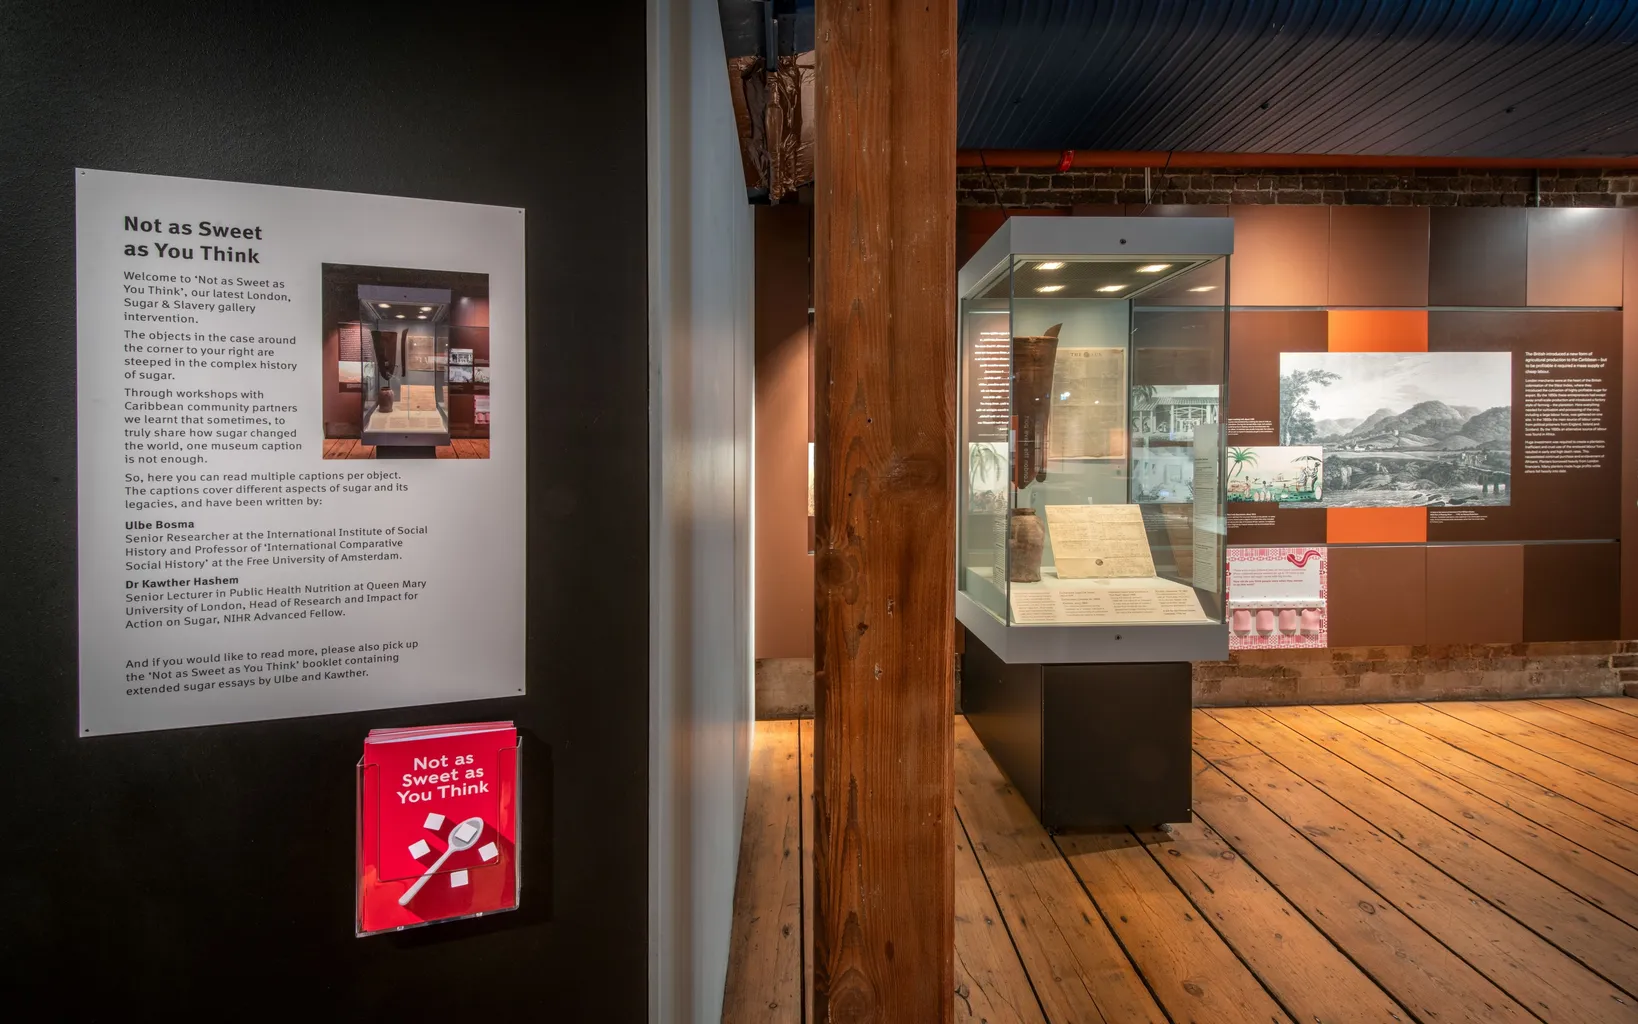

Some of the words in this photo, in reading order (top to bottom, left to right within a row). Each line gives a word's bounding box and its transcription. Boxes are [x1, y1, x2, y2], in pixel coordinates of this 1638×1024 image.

[124, 215, 162, 233] Not
[168, 222, 193, 236] as
[198, 221, 262, 240] Sweet
[124, 244, 149, 257] as
[154, 242, 194, 260] You
[200, 245, 260, 264] Think
[123, 271, 177, 283] Welcome
[180, 275, 191, 284] to
[194, 275, 218, 285] ‘Not
[221, 278, 234, 286] as
[236, 277, 270, 288] Sweet
[272, 281, 285, 289] as
[123, 284, 145, 294] You
[148, 285, 188, 297] Think’,
[191, 289, 210, 297] our
[213, 289, 244, 299] latest
[247, 291, 291, 302] London,
[124, 297, 159, 310] Sugar
[161, 300, 171, 309] &
[173, 300, 215, 312] Slavery
[218, 303, 256, 314] gallery
[124, 311, 199, 324] intervention.
[124, 330, 146, 340] The
[148, 331, 192, 342] objects
[194, 332, 205, 341] in
[208, 333, 227, 343] the
[229, 335, 255, 343] case
[258, 336, 296, 345] around
[124, 343, 143, 353] the
[146, 346, 184, 354] corner
[186, 346, 198, 355] to
[200, 347, 226, 357] your
[228, 346, 254, 358] right
[257, 349, 275, 357] are
[124, 357, 171, 368] steeped
[174, 357, 185, 367] in
[188, 358, 207, 368] the
[210, 360, 257, 370] complex
[260, 360, 297, 372] history
[124, 370, 137, 379] of
[139, 372, 175, 382] sugar.
[124, 388, 173, 400] Through
[176, 389, 238, 400] workshops
[240, 390, 264, 399] with
[124, 401, 184, 411] Caribbean
[187, 402, 250, 414] community
[252, 404, 298, 414] partners
[124, 416, 141, 424] we
[144, 414, 178, 424] learnt
[181, 415, 204, 425] that
[207, 415, 272, 426] sometimes,
[274, 417, 286, 425] to
[124, 428, 151, 439] truly
[154, 428, 186, 437] share
[189, 428, 213, 437] how
[216, 430, 248, 439] sugar
[250, 428, 297, 440] changed
[124, 441, 144, 450] the
[146, 441, 183, 451] world,
[186, 443, 208, 451] one
[261, 441, 302, 452] caption
[125, 454, 135, 464] is
[138, 455, 157, 464] not
[160, 454, 208, 465] enough.
[125, 473, 144, 483] So,
[147, 473, 173, 482] here
[176, 474, 196, 483] you
[200, 474, 220, 482] can
[223, 472, 247, 481] read
[251, 472, 296, 482] multiple
[298, 471, 344, 482] captions
[347, 473, 364, 482] per
[366, 471, 401, 481] object.
[125, 486, 147, 495] The
[149, 486, 200, 497] captions
[202, 487, 233, 495] cover
[235, 484, 283, 494] different
[285, 485, 327, 495] aspects
[329, 483, 341, 492] of
[342, 485, 372, 494] sugar
[374, 483, 393, 492] and
[396, 483, 408, 491] its
[125, 499, 177, 511] legacies,
[181, 498, 202, 508] and
[206, 498, 233, 507] have
[235, 498, 263, 507] been
[265, 497, 303, 506] written
[306, 496, 322, 507] by:
[125, 520, 153, 530] Ulbe
[155, 520, 195, 529] Bosma
[125, 533, 164, 544] Senior
[167, 532, 230, 542] Researcher
[232, 532, 243, 540] at
[246, 531, 264, 540] the
[267, 528, 336, 539] International
[339, 527, 383, 537] Institute
[385, 526, 396, 535] of
[397, 526, 428, 535] Social
[125, 560, 161, 571] Social
[165, 559, 209, 570] History’
[211, 559, 223, 567] at
[225, 558, 244, 567] the
[247, 557, 269, 566] Free
[272, 554, 326, 565] University
[328, 553, 339, 563] of
[340, 552, 402, 562] Amsterdam.
[125, 580, 139, 589] Dr
[142, 578, 191, 588] Kawther
[193, 576, 239, 586] Hashem
[125, 658, 149, 668] And
[152, 657, 161, 667] if
[162, 658, 183, 668] you
[186, 653, 221, 664] would
[224, 652, 244, 662] like
[246, 652, 258, 660] to
[261, 649, 284, 659] read
[288, 649, 318, 657] more,
[321, 645, 356, 657] please
[358, 643, 380, 652] also
[382, 641, 404, 652] pick
[406, 641, 418, 650] up
[126, 673, 145, 682] the
[148, 671, 172, 680] ‘Not
[175, 670, 188, 678] as
[191, 667, 225, 677] Sweet
[228, 666, 241, 674] as
[243, 664, 263, 673] You
[266, 660, 299, 671] Think’
[302, 658, 342, 669] booklet
[344, 654, 399, 665] containing
[414, 755, 448, 771] Not
[454, 754, 474, 766] as
[402, 768, 459, 788] Sweet
[465, 768, 484, 779] as
[396, 790, 432, 804] You
[437, 780, 489, 798] Think
